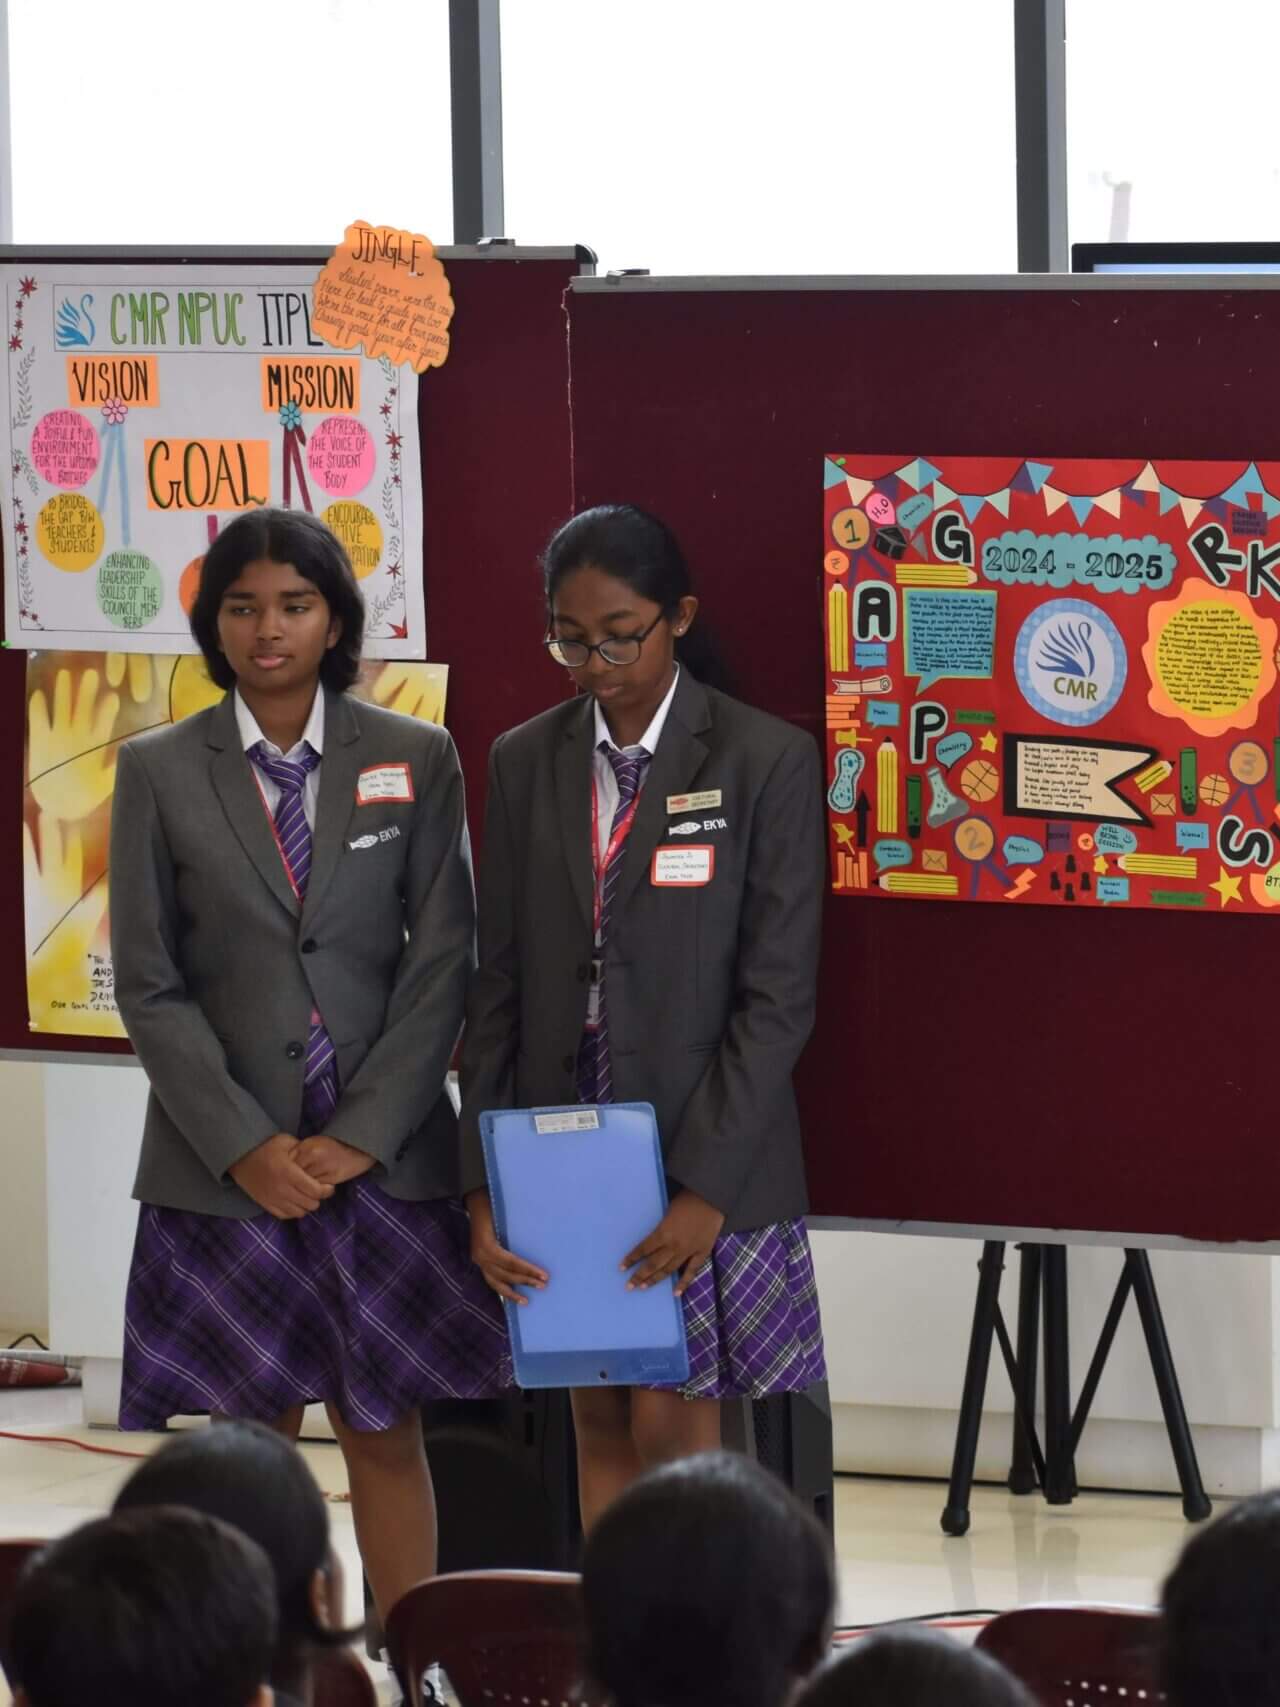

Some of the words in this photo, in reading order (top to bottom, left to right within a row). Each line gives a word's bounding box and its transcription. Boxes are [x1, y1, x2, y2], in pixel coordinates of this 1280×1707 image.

[351, 226, 424, 277] JINGLE
[110, 292, 170, 345] CMR
[177, 292, 247, 345] NPUC
[257, 292, 324, 346] ITPL
[72, 360, 150, 402] VISION
[267, 364, 356, 409] MISSION
[32, 440, 93, 455] ENVIRONMENT
[311, 436, 326, 450] THE
[330, 436, 351, 451] VOICE
[355, 436, 367, 450] OF
[53, 455, 66, 469] THE
[308, 455, 323, 469] THE
[326, 453, 362, 470] STUDENT
[148, 440, 267, 509] GOAL
[323, 470, 348, 489] BODY
[59, 493, 88, 510] BRIDGE
[40, 511, 55, 525] THE
[45, 525, 87, 540] TEACHERS
[844, 519, 861, 543] 1
[935, 514, 972, 564] G
[49, 539, 96, 554] STUDENTS
[1192, 526, 1243, 583] R
[106, 553, 150, 570] ENHANCING
[986, 546, 1057, 574] 2024
[1085, 552, 1163, 580] 2025
[99, 567, 146, 585] LEADERSHIP
[100, 586, 126, 600] SKILLS
[128, 585, 139, 600] OF
[142, 587, 157, 602] THE
[102, 602, 138, 616] COUNCIL
[858, 587, 891, 637] A
[1054, 676, 1098, 701] CMR
[914, 705, 946, 760] P
[703, 817, 727, 831] EKYA
[379, 825, 400, 842] EKYA
[965, 826, 986, 850] 2
[1220, 818, 1269, 863] S
[92, 967, 112, 977] AND
